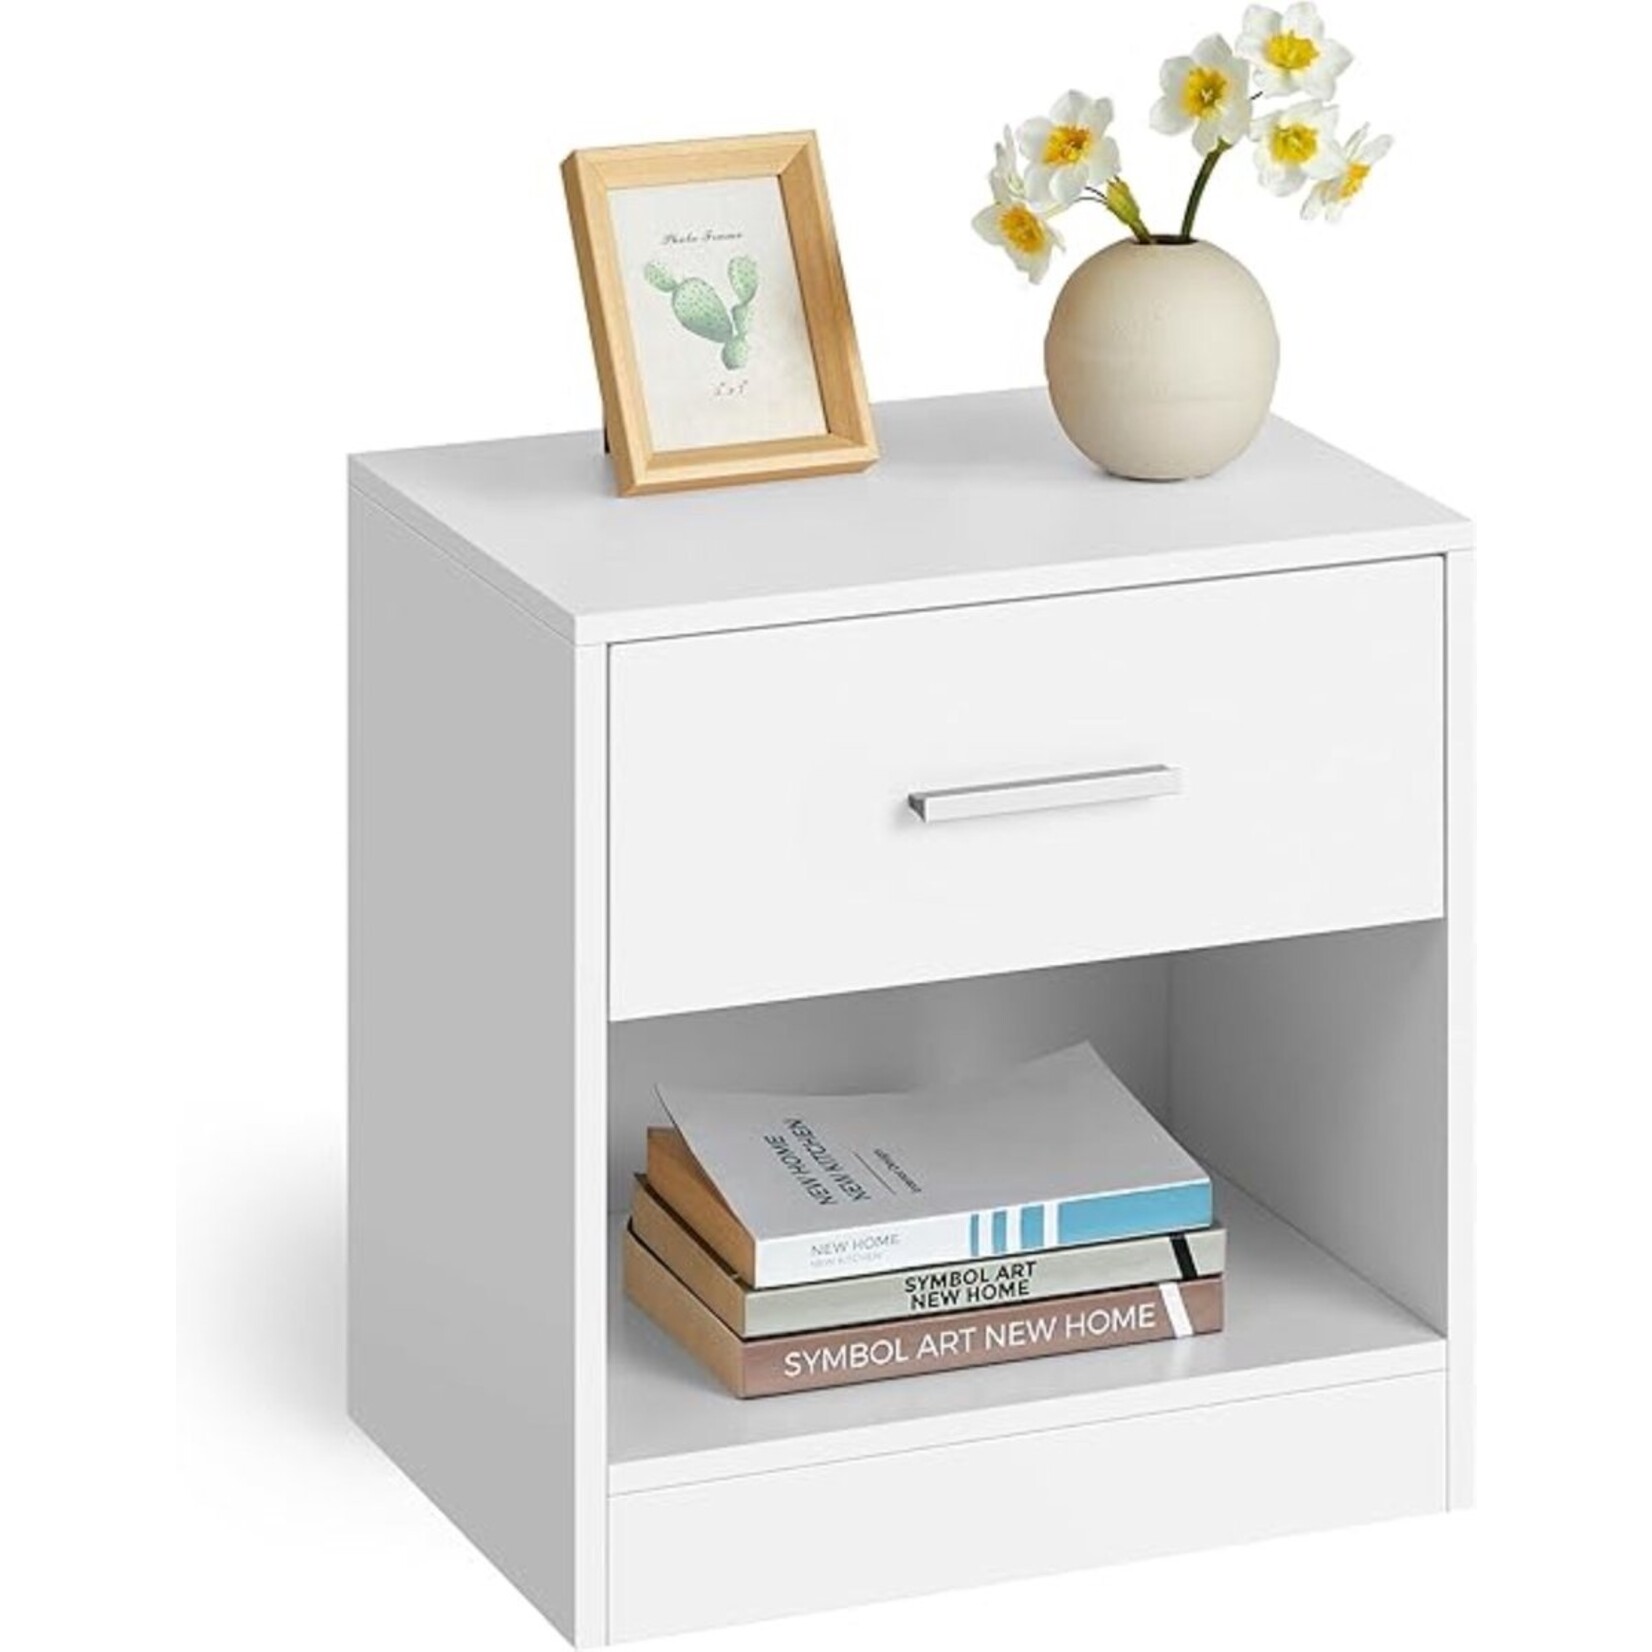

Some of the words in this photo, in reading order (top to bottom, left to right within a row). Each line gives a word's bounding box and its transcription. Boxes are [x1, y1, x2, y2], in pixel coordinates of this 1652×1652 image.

[763, 1135, 810, 1175] HOME
[783, 1117, 844, 1172] KITCHEN
[797, 1176, 838, 1205] NEW
[829, 1172, 871, 1202] NEW
[810, 1240, 850, 1256] NEW
[852, 1233, 901, 1251] HOME
[904, 1267, 989, 1293] SYMBOL
[995, 1260, 1037, 1281] ART
[911, 1290, 961, 1310] NEW
[966, 1279, 1030, 1303] HOME
[783, 1338, 909, 1378] SYMBOL
[916, 1326, 977, 1360] ART
[984, 1316, 1057, 1351] NEW
[1065, 1302, 1157, 1339] HOME
